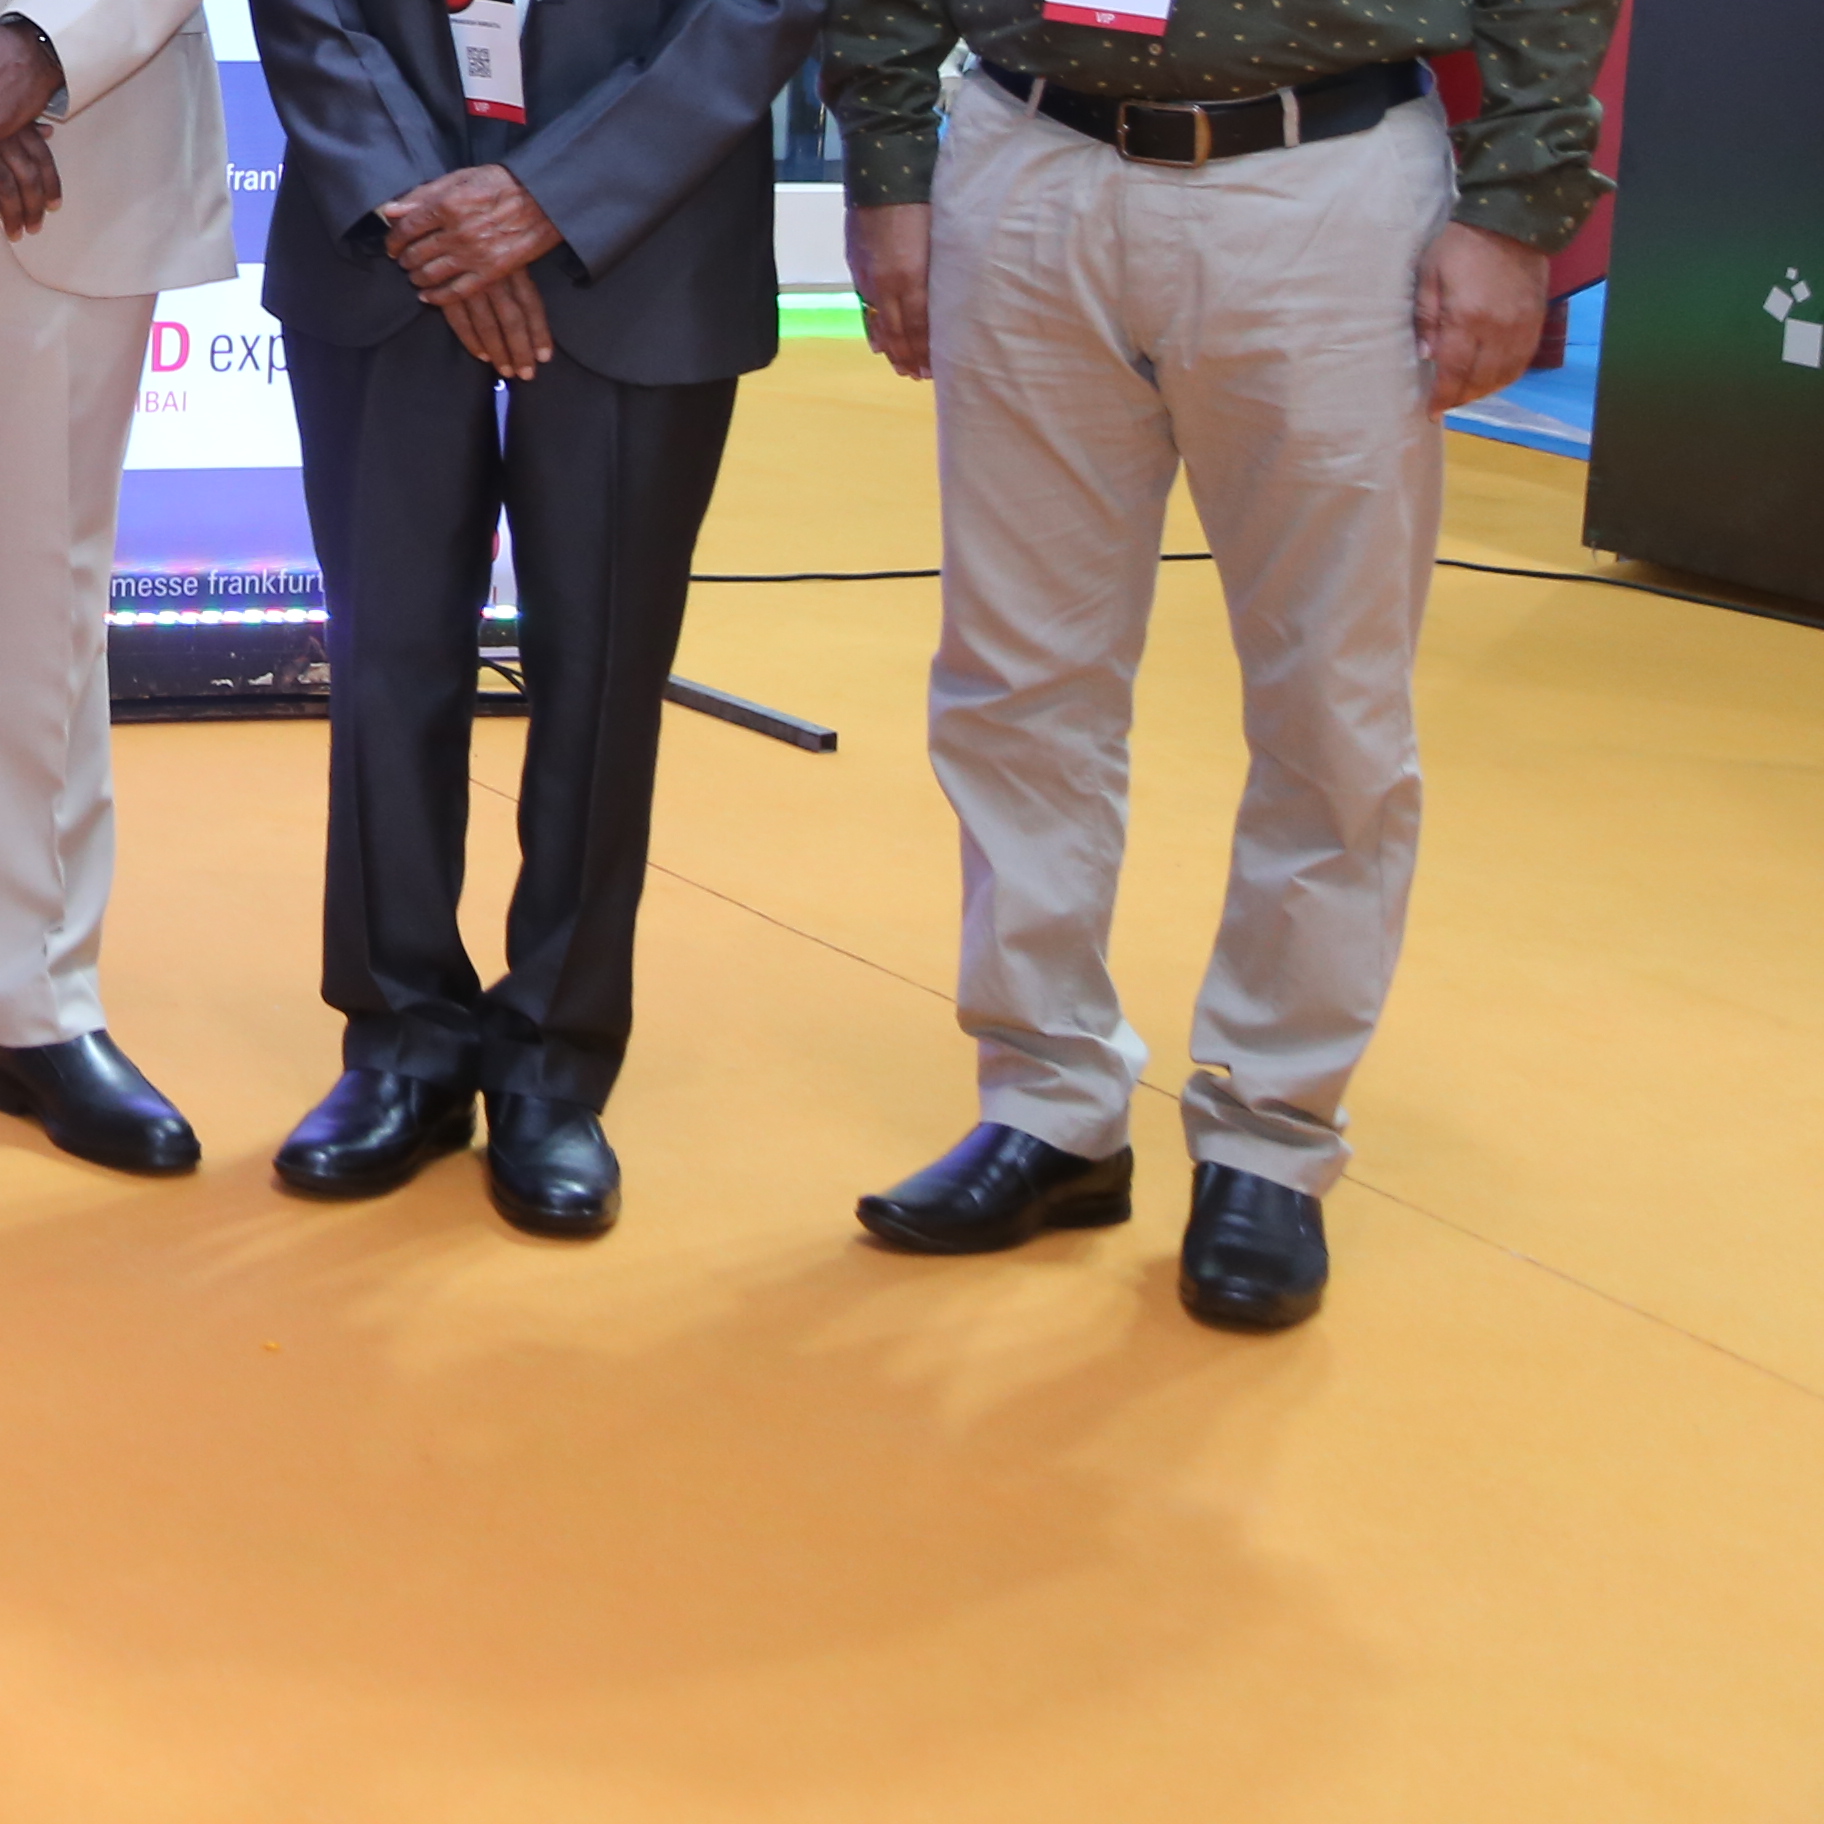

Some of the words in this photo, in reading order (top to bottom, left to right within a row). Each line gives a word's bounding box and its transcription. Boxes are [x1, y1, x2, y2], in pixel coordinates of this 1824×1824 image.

[1094, 12, 1115, 24] VIP
[210, 333, 287, 385] exp
[111, 577, 198, 598] messe
[207, 569, 323, 597] frankfurt
